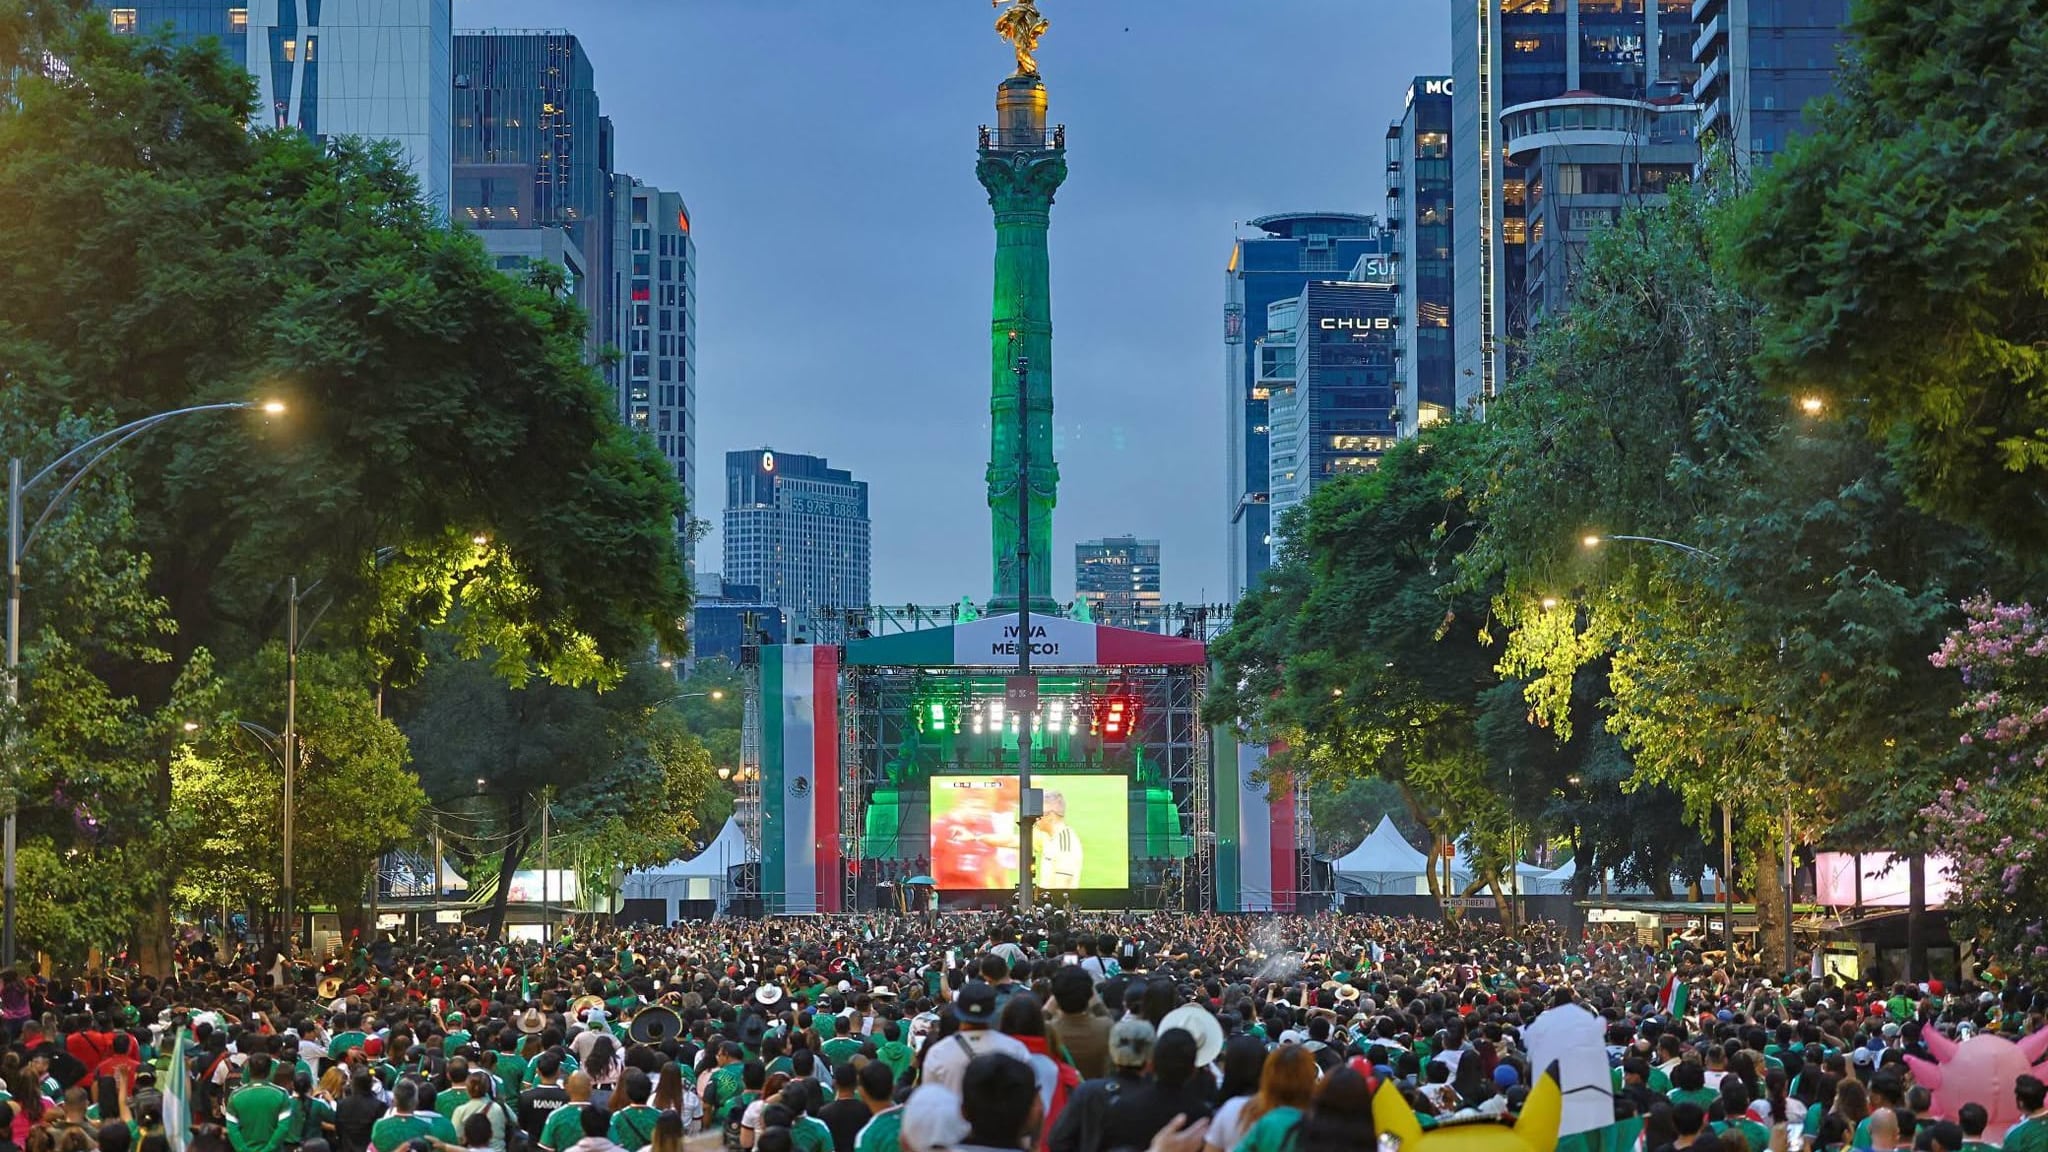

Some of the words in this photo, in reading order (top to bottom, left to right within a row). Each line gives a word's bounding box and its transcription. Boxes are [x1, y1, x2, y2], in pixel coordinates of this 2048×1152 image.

[1367, 262, 1395, 275] SU
[1321, 318, 1396, 329] CHUB
[793, 498, 804, 512] 55
[806, 500, 831, 515] 9765
[834, 503, 858, 518] 8888
[1004, 625, 1047, 638] ¡VVA
[992, 640, 1059, 655] MÉCO!
[1466, 968, 1474, 980] 3
